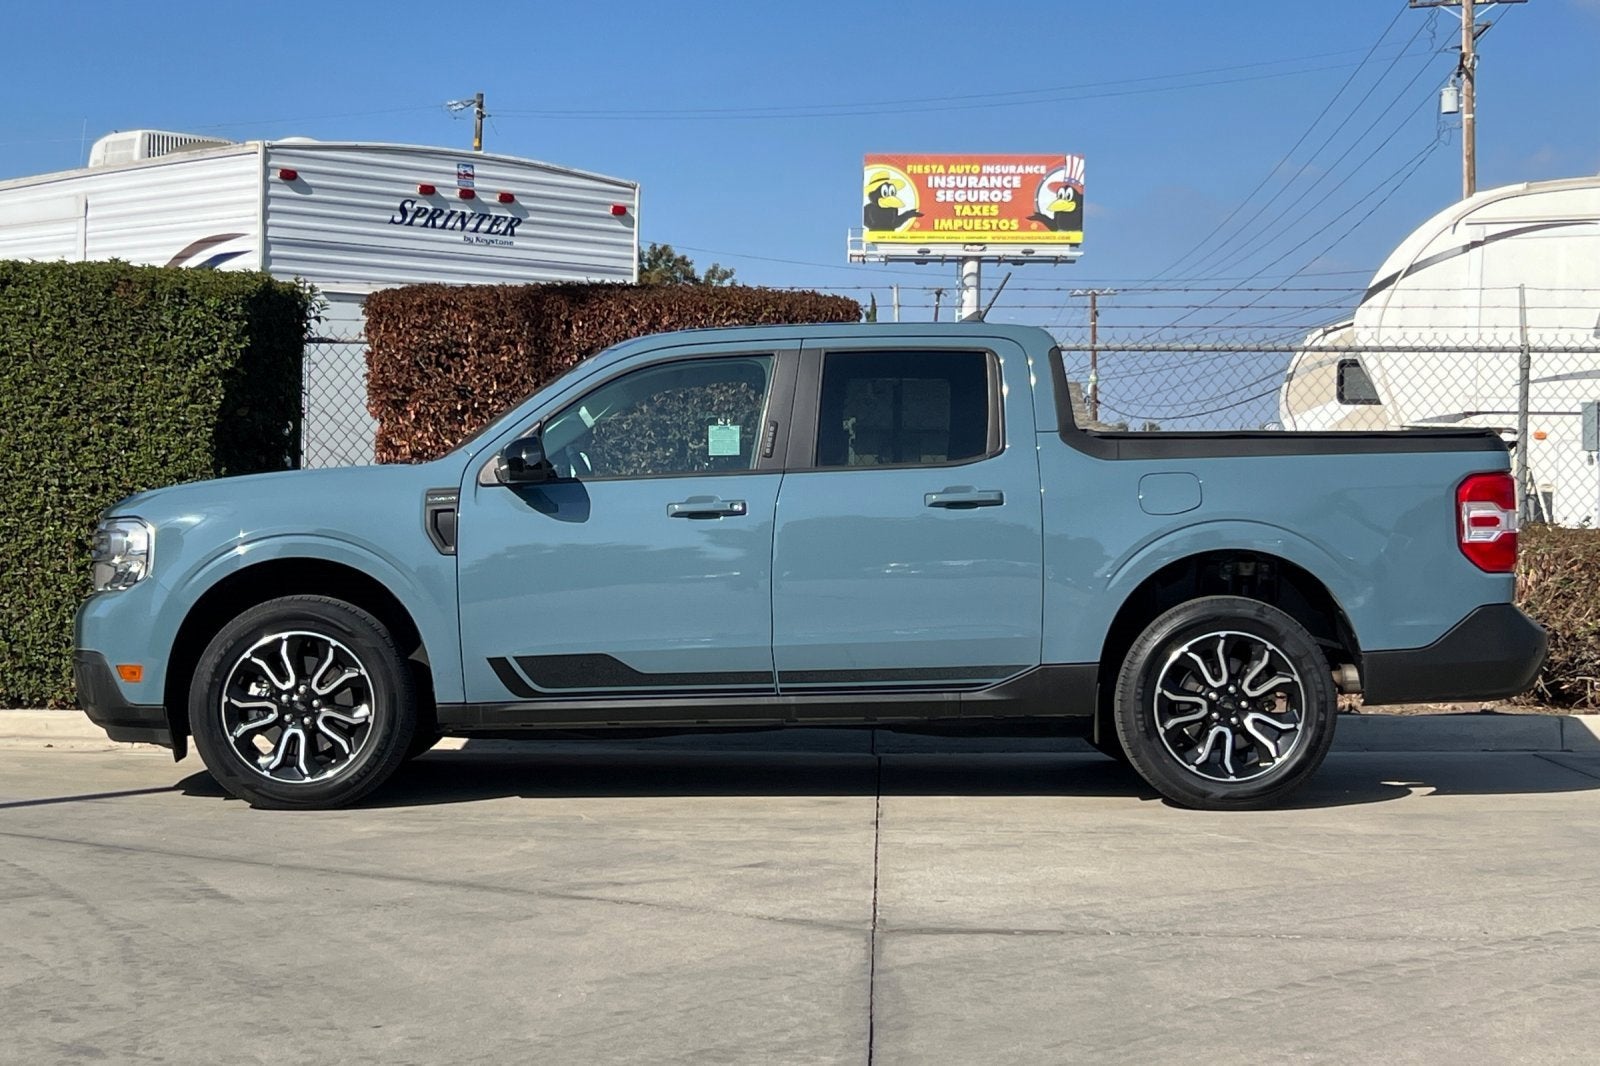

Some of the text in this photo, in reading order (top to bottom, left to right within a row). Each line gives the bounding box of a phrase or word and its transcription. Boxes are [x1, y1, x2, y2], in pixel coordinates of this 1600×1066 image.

[906, 164, 1047, 175] FIESTA AUTO INSURANCE
[927, 176, 1022, 189] INSURANCE
[936, 190, 1012, 203] SEGUROS
[953, 204, 1000, 217] TAXES
[388, 199, 523, 237] SPRINTER
[933, 218, 1020, 232] IMPUESTOS
[463, 235, 514, 246] by Keystone
